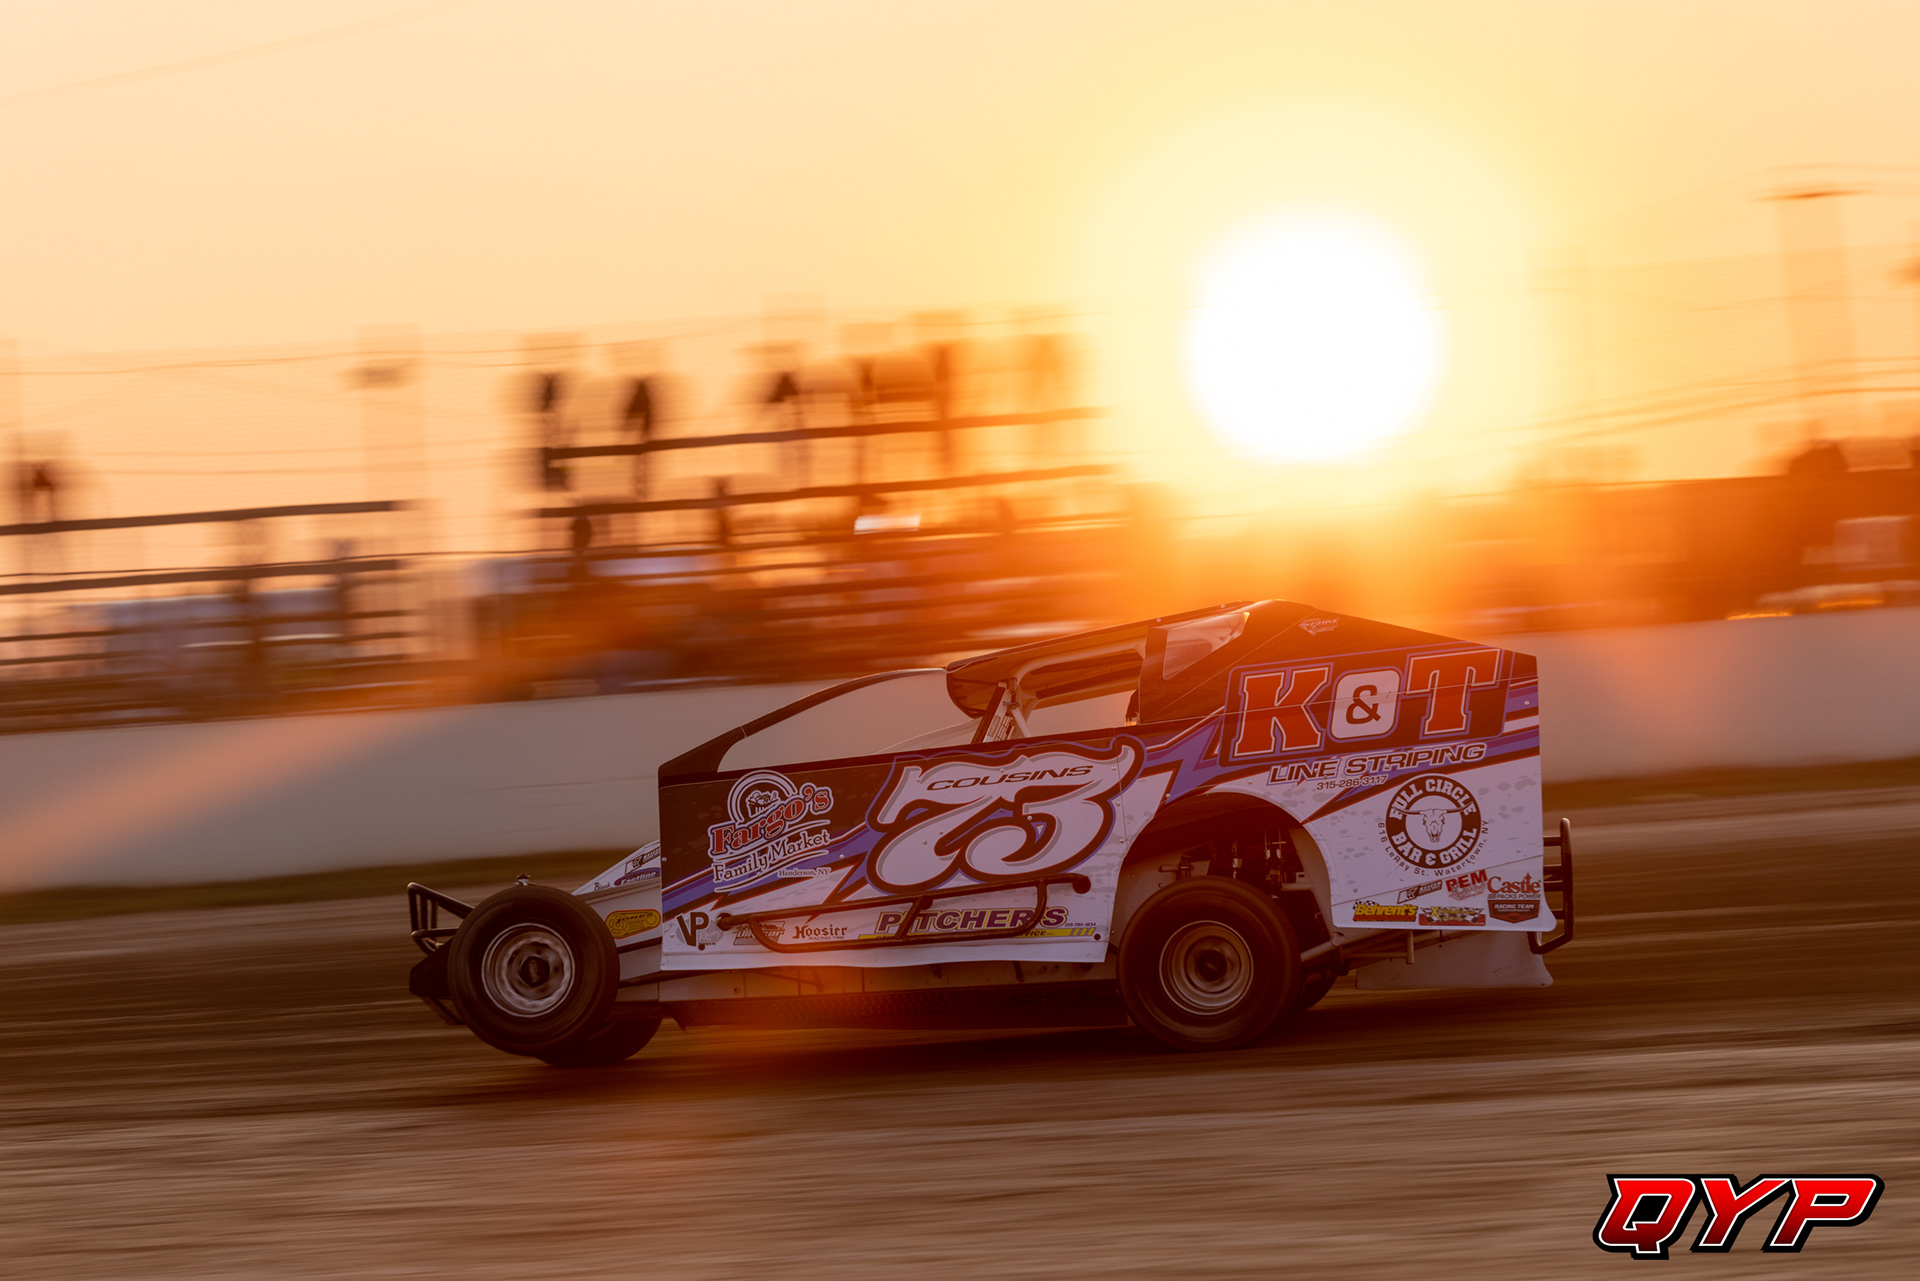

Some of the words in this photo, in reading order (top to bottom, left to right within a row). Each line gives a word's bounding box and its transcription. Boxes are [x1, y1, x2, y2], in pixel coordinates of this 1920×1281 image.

[1234, 648, 1500, 757] K&T
[926, 765, 1094, 791] COUSINS
[1268, 759, 1340, 784] LINE
[1346, 743, 1486, 776] STRIPING
[1316, 775, 1388, 791] 315-286-3117
[1389, 783, 1423, 820] FULL
[1424, 778, 1477, 816] CIRCLE
[711, 786, 832, 855] Fargo's
[870, 743, 1140, 889] 73
[713, 852, 769, 881] Family
[771, 831, 829, 862] Market
[1377, 822, 1388, 843] 616
[1385, 845, 1410, 872] LeRay
[1413, 866, 1429, 876] St.
[1481, 820, 1489, 834] NY
[1391, 831, 1423, 863] BAR
[1439, 828, 1478, 864] GRILL
[779, 869, 815, 877] Henderson,
[1445, 869, 1488, 892] PEM
[1488, 872, 1541, 894] Castle
[1355, 904, 1418, 916] Behrent's
[677, 911, 710, 947] VP
[791, 924, 848, 939] Hoosier
